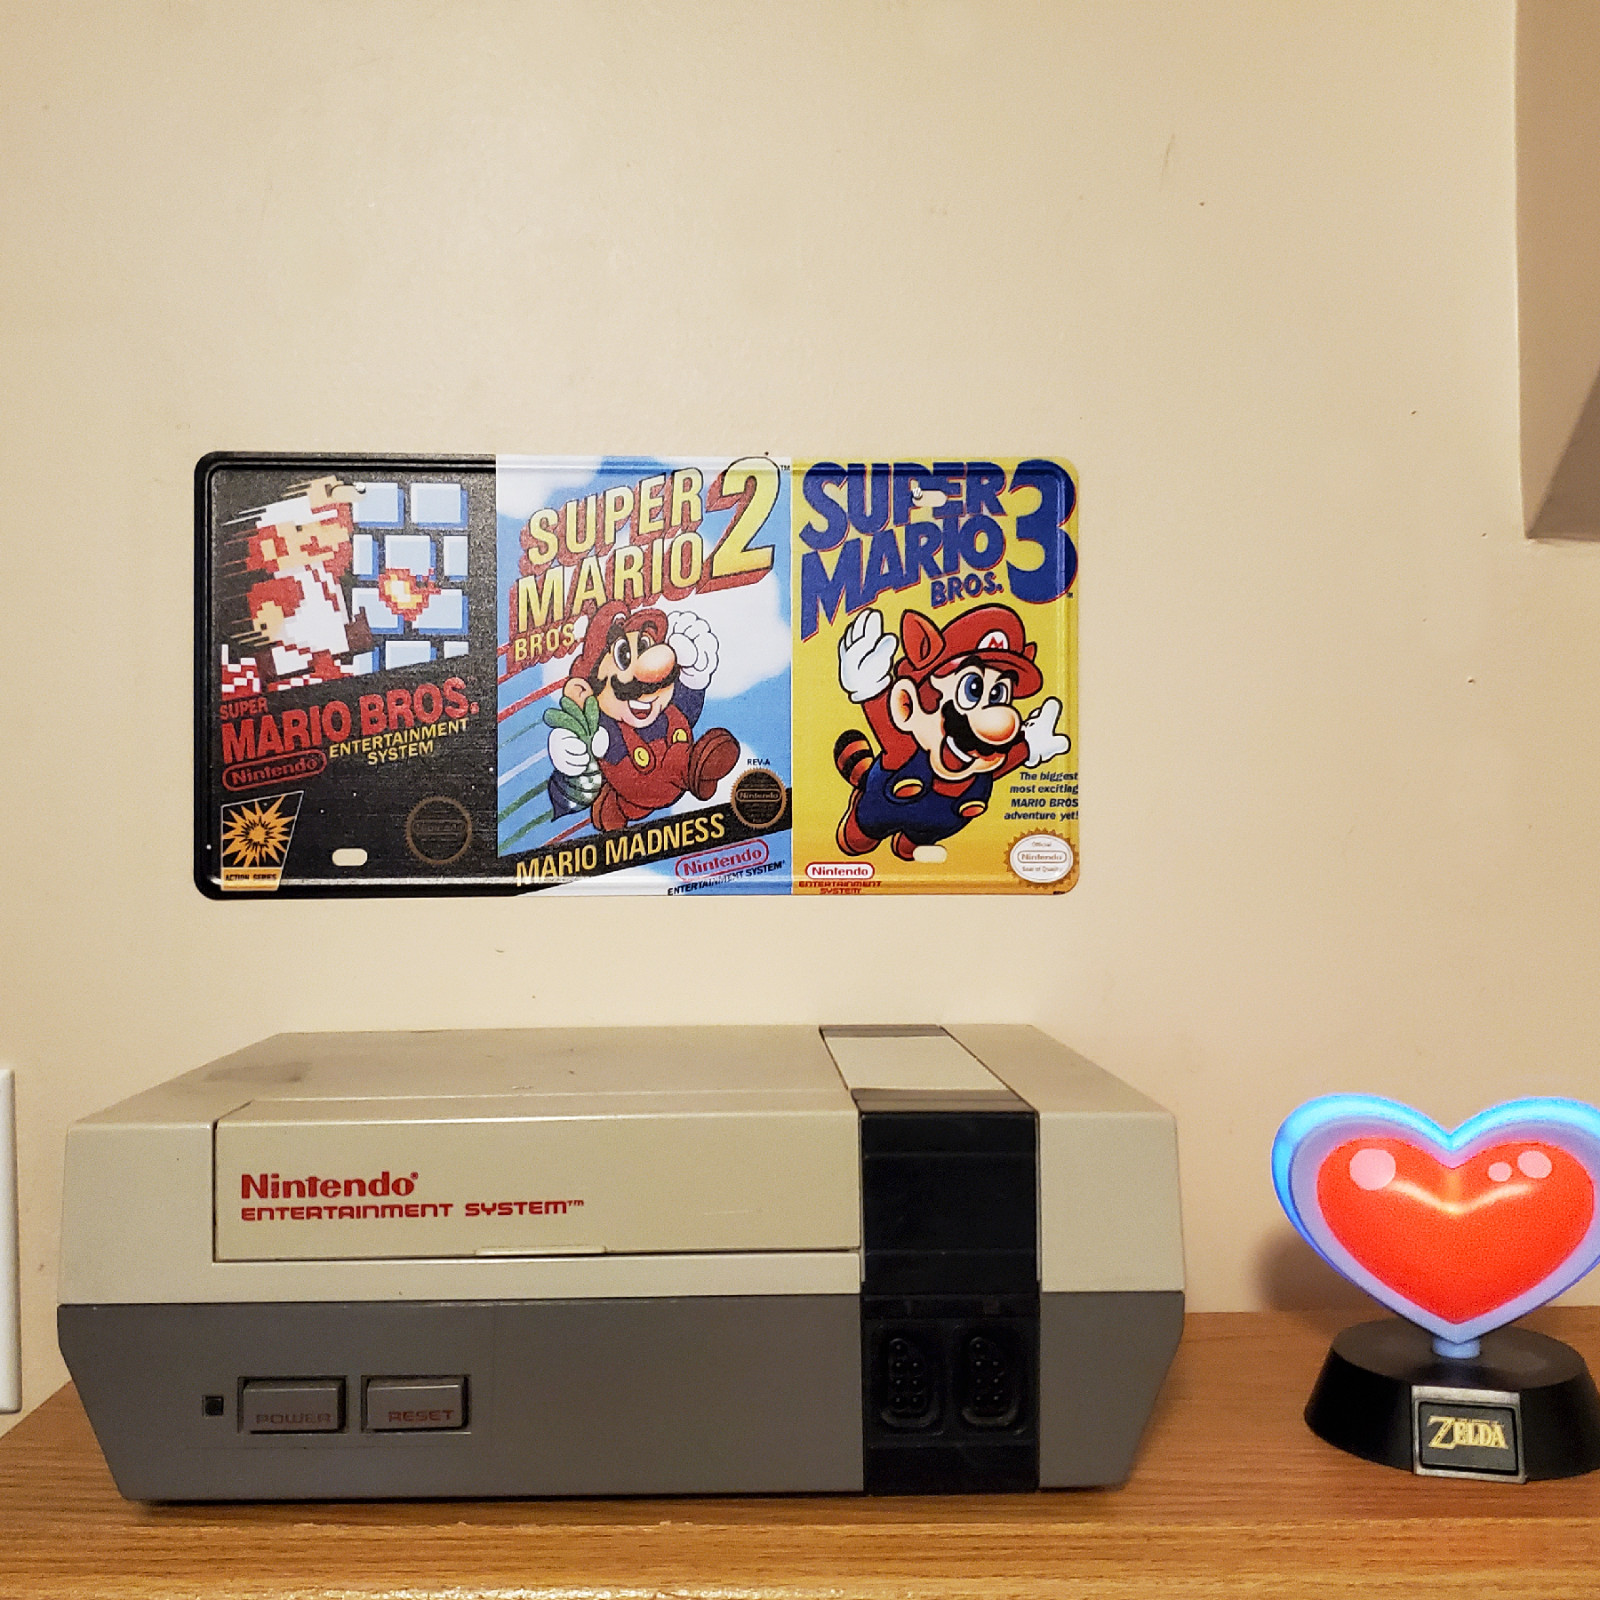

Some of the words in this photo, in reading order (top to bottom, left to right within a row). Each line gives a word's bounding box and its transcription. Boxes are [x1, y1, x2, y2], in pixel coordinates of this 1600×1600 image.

[523, 467, 705, 569] SUPER
[800, 461, 1007, 552] SUPER
[1006, 459, 1078, 604] 3
[515, 531, 705, 634] MARIO
[801, 515, 1006, 643] MARIO
[219, 697, 268, 721] SUPER
[221, 700, 349, 764] MARIO
[329, 718, 469, 759] ENTERTAINMENT
[367, 740, 434, 765] SYSTEM
[231, 757, 318, 785] Nintendo
[1019, 772, 1038, 781] The
[1040, 771, 1079, 782] biggest
[739, 791, 779, 799] Nintendo
[1010, 784, 1036, 794] most
[1038, 784, 1079, 795] exciting
[1011, 798, 1047, 808] MARIO
[1049, 798, 1079, 808] BROS
[1004, 811, 1057, 820] adventure
[1060, 810, 1079, 822] yet!
[516, 844, 598, 887] MARIO
[605, 813, 725, 866] MADNESS
[683, 847, 763, 877] Nintendo
[667, 871, 744, 897] ENTERTAINMENT
[798, 880, 882, 888] ENTERTAINMENT
[811, 866, 869, 877] Nintendo
[819, 887, 862, 895] SYSTEM
[241, 1203, 454, 1221] ENTERTAINMENT
[255, 1412, 332, 1425] POWER
[387, 1409, 455, 1423] RESET
[1427, 1415, 1509, 1450] ZELDA
